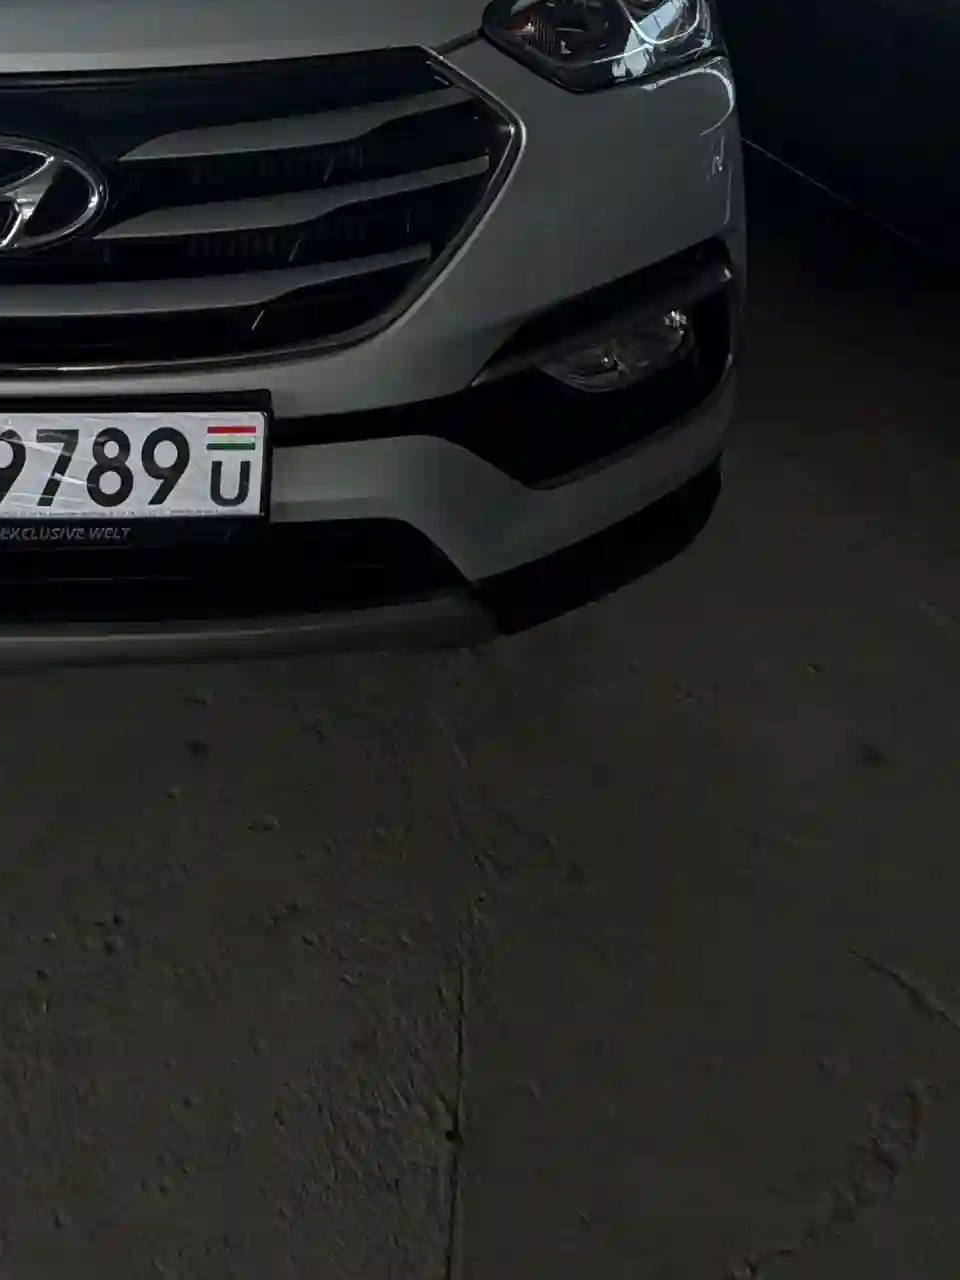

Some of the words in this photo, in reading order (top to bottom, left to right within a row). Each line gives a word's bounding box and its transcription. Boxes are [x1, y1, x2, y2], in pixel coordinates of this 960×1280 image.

[209, 459, 251, 507] U
[0, 526, 86, 541] EXCLUSIVE
[89, 526, 131, 541] WELT
